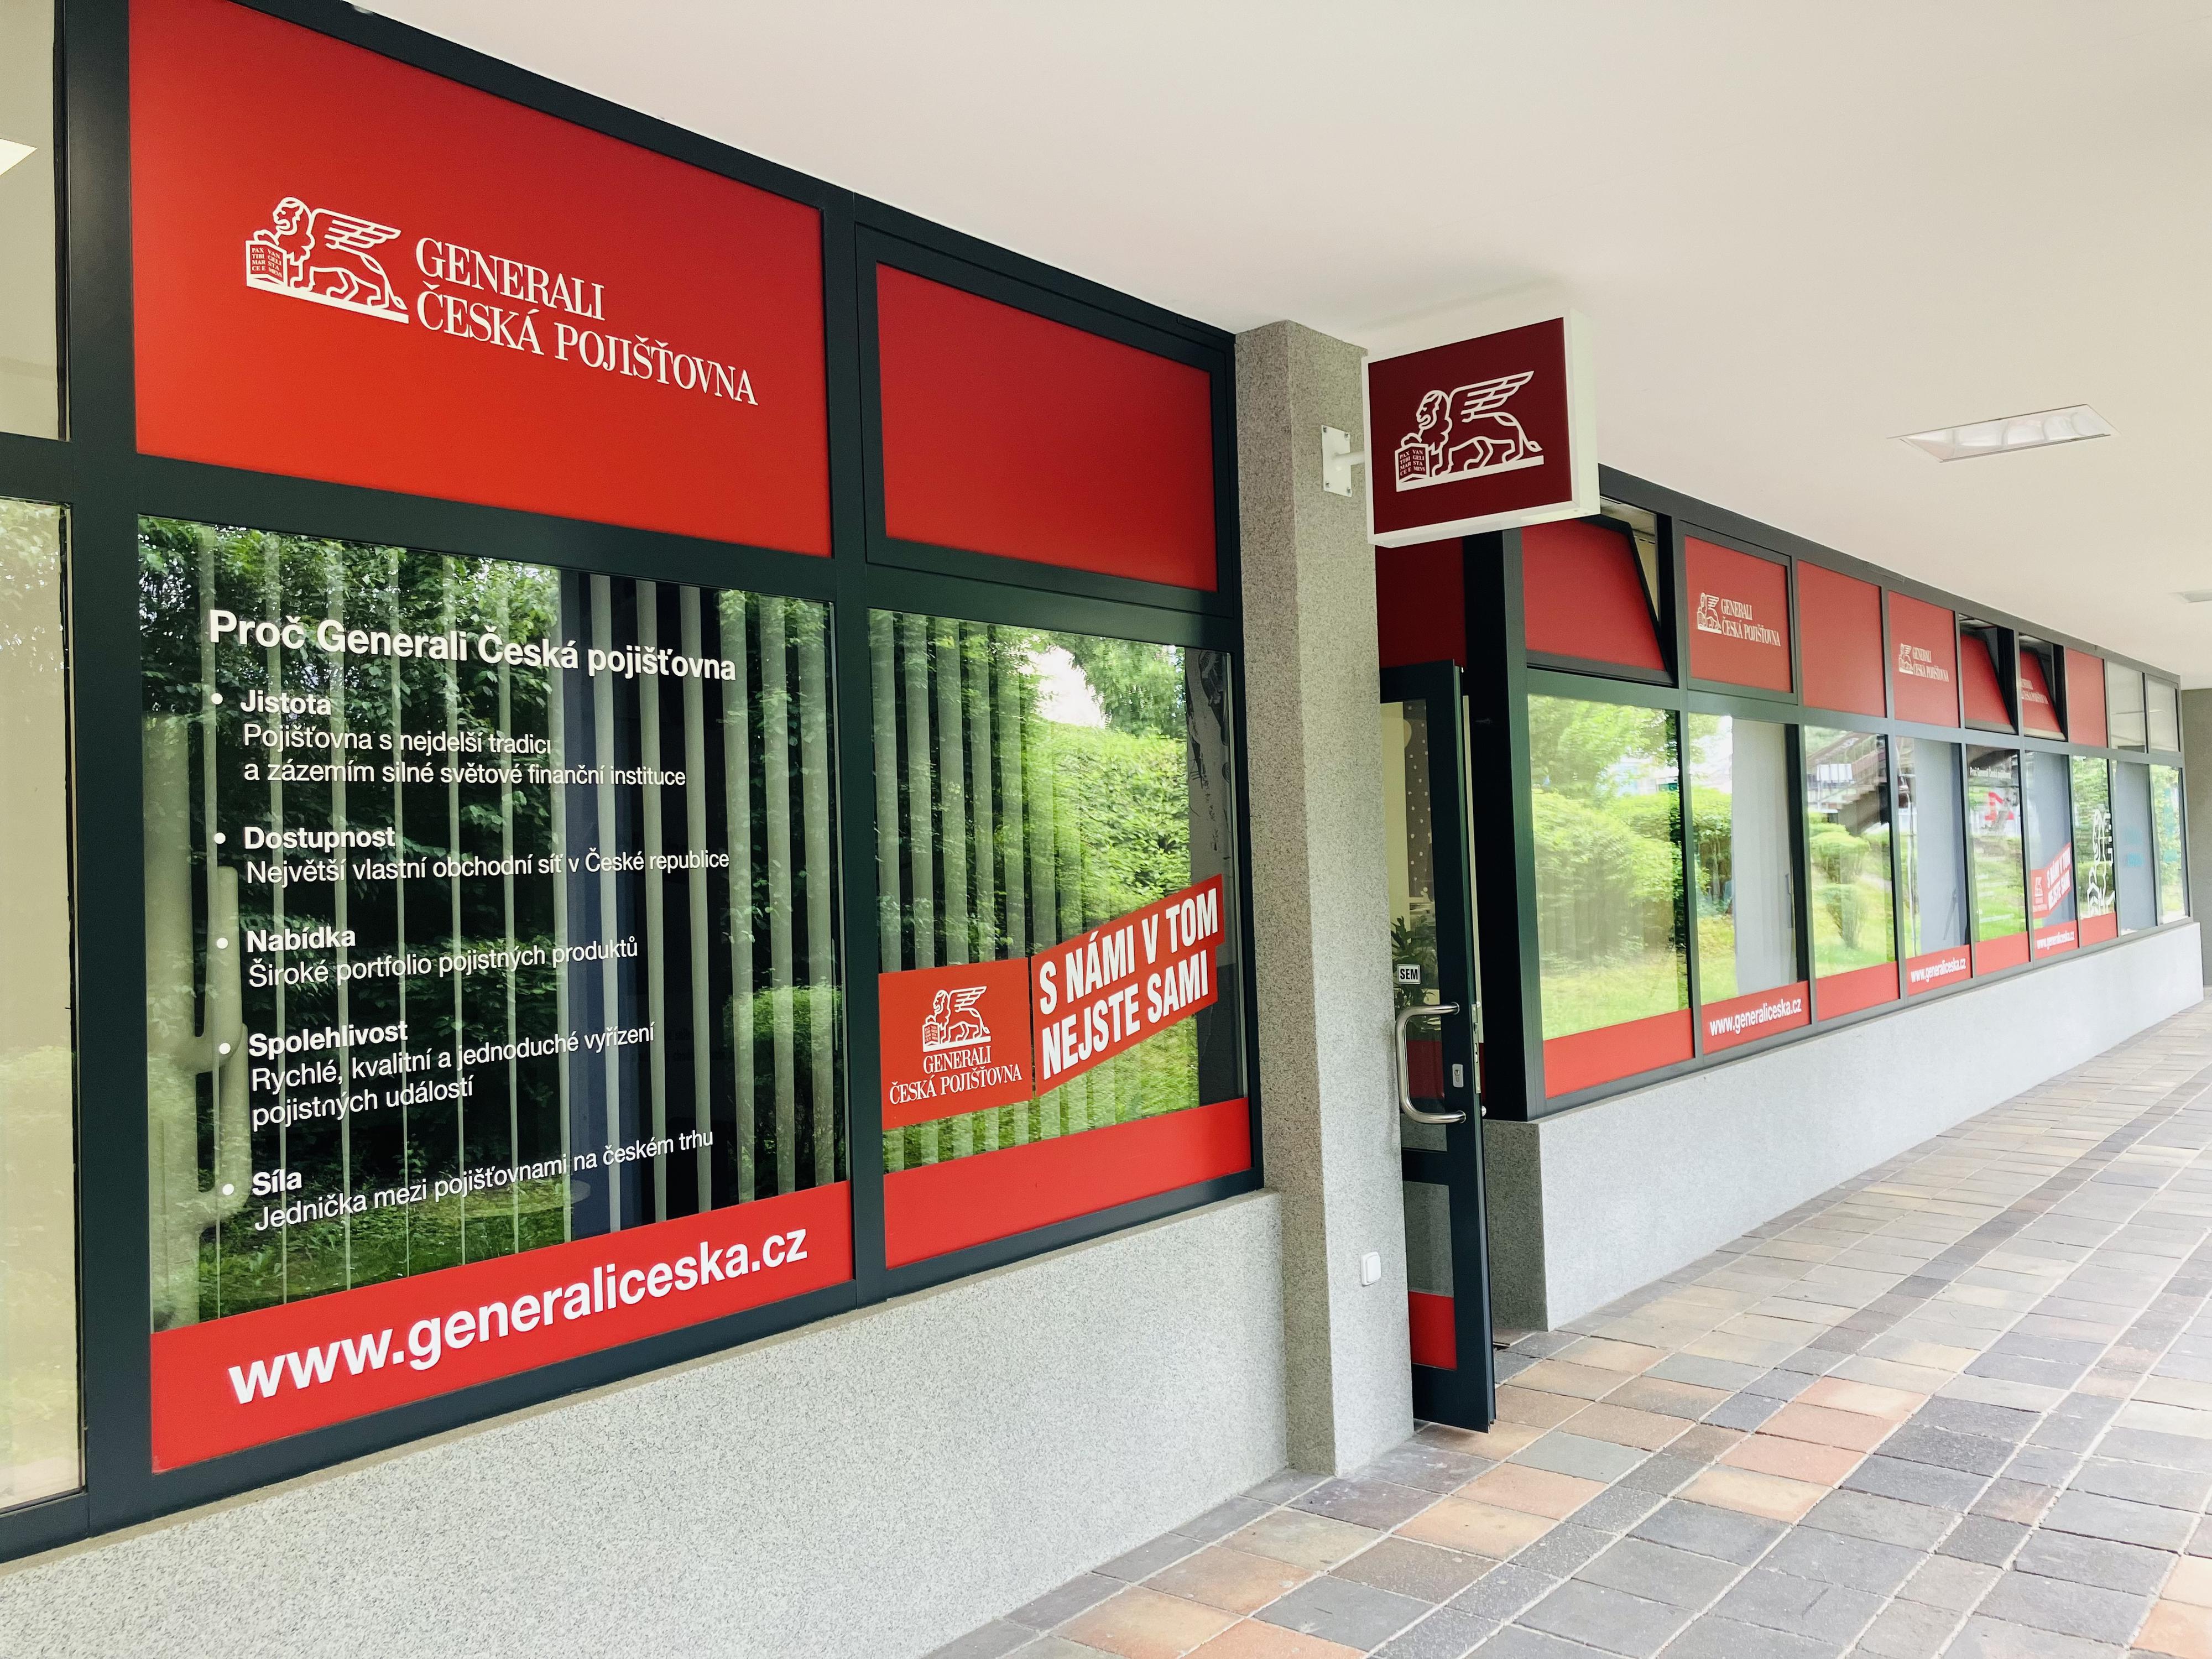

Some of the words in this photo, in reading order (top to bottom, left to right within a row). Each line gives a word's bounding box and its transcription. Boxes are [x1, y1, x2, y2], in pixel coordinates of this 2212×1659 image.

[415, 237, 606, 320] GENERALI
[416, 281, 544, 356] ČESKÁ
[553, 322, 758, 405] POJIŠŤOVNA
[209, 609, 304, 648] Proč
[317, 619, 467, 660] Generali
[478, 626, 578, 669] Česká
[587, 645, 736, 680] pojišťovna
[240, 690, 331, 716] Jistota
[243, 723, 372, 752] Pojišťovna
[379, 733, 392, 750] s
[400, 731, 483, 755] nejdelší
[244, 763, 259, 780] a
[268, 759, 374, 781] zázemím
[382, 761, 434, 782] silné
[441, 763, 522, 784] světové
[529, 763, 604, 784] finanční
[611, 766, 685, 786] instituce
[244, 826, 395, 852] Dostupnost
[247, 858, 346, 888] Největší
[353, 855, 426, 879] vlastní
[432, 853, 533, 878] obchodní
[538, 853, 565, 873] síť
[569, 856, 579, 872] v
[585, 847, 644, 872] České
[649, 849, 729, 875] republice
[247, 926, 355, 952] Nabídka
[1040, 961, 1057, 1015] S
[1066, 930, 1134, 1001] NÁMI
[1141, 914, 1159, 965] V
[1166, 888, 1218, 952] TOM
[248, 959, 328, 987] Široké
[337, 954, 431, 985] portfolio
[439, 947, 545, 977] pojistných
[553, 936, 638, 967] produktů
[1400, 968, 1418, 979] SEM
[1042, 983, 1140, 1080] NEJSTE
[1147, 950, 1208, 1023] SAMI
[1710, 999, 1802, 1036] www.generaliceska.cz
[249, 1020, 408, 1061] Spolehlivost
[252, 1060, 343, 1095] Rychlé,
[351, 1049, 432, 1079] kvalitní
[439, 1050, 451, 1068] a
[457, 1032, 578, 1070] jednoduché
[585, 1022, 655, 1053] vyřízení
[924, 1046, 991, 1075] GENERALI
[253, 1088, 378, 1131] pojistných
[386, 1077, 473, 1106] událostí
[890, 1076, 936, 1104] ČESKÁ
[940, 1064, 1022, 1095] POJIŠŤOVNA
[253, 1168, 302, 1196] Síla
[255, 1189, 367, 1231] Jednička
[374, 1178, 426, 1207] mezi
[435, 1154, 567, 1202] pojišťovnami
[573, 1151, 597, 1171] na
[603, 1137, 674, 1165] českém
[679, 1130, 713, 1151] trhu
[228, 1228, 808, 1405] www.generaliceska.cz
